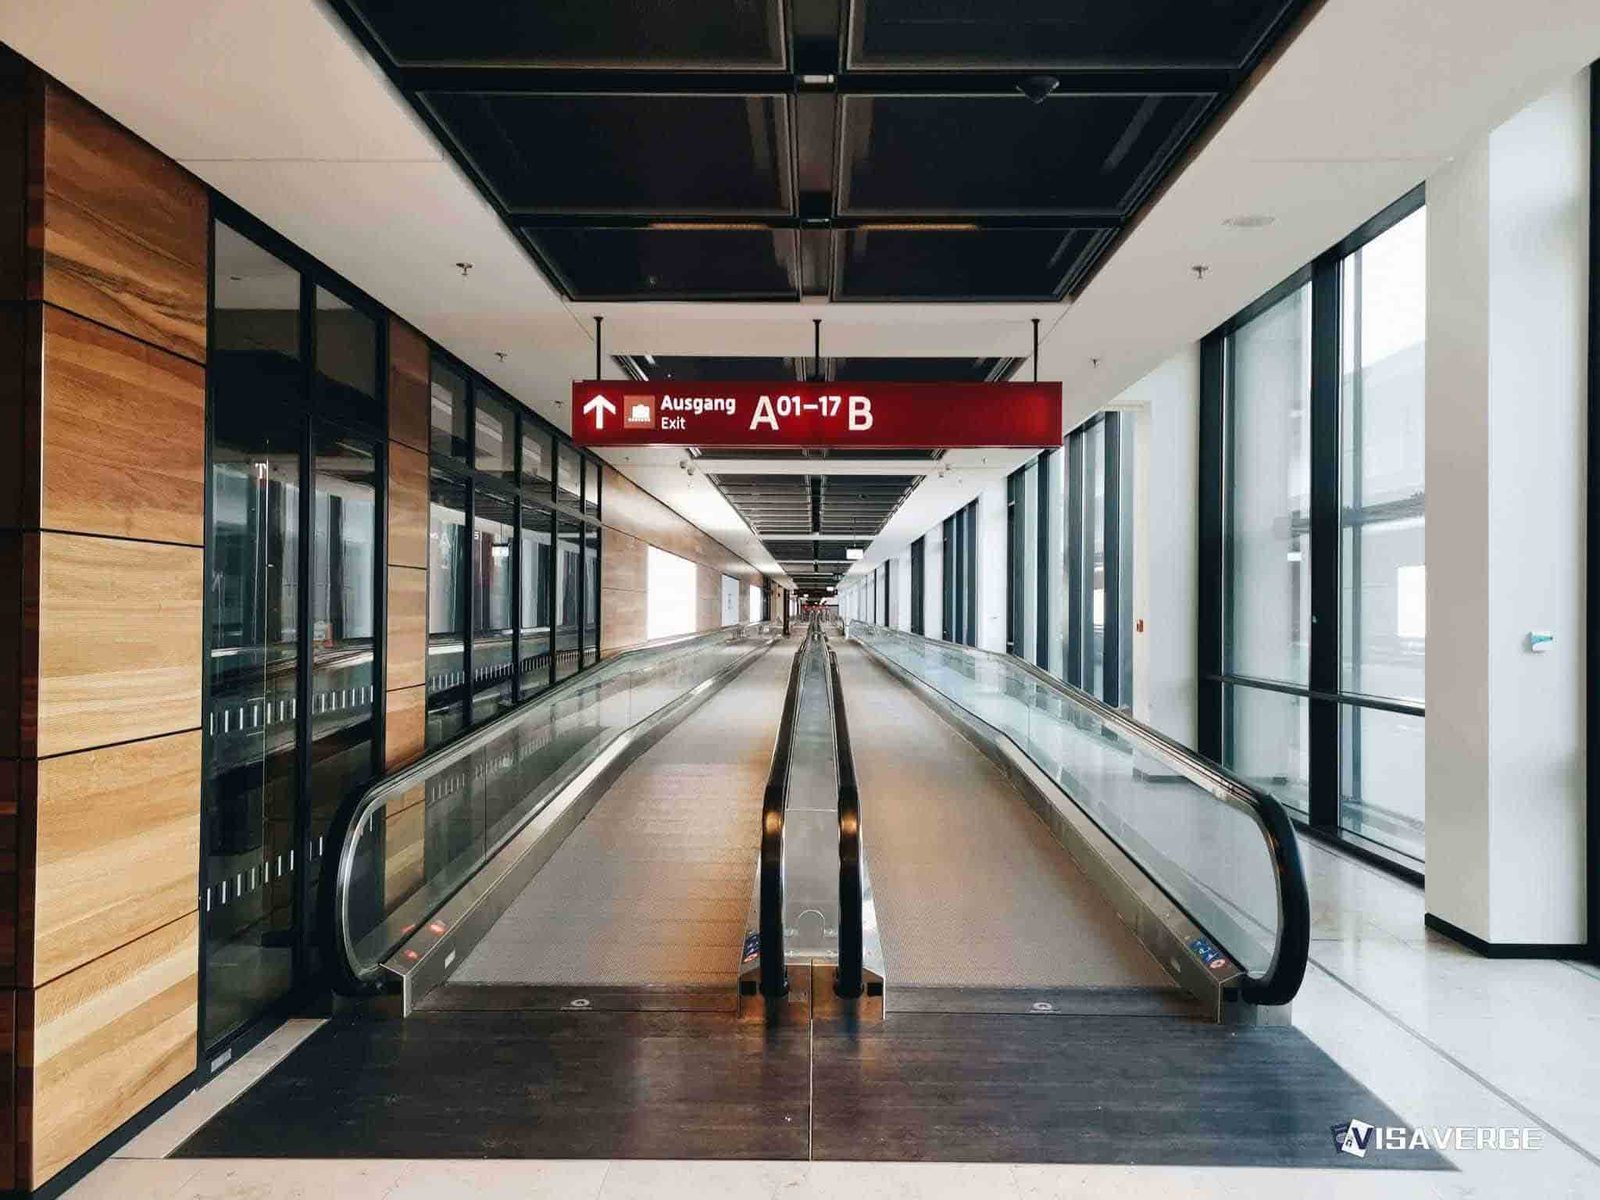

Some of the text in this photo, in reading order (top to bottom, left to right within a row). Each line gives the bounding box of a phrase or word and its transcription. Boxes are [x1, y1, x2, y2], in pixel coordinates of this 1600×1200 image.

[660, 394, 736, 415] Ausgang
[848, 395, 874, 431] B
[661, 416, 687, 430] Exit
